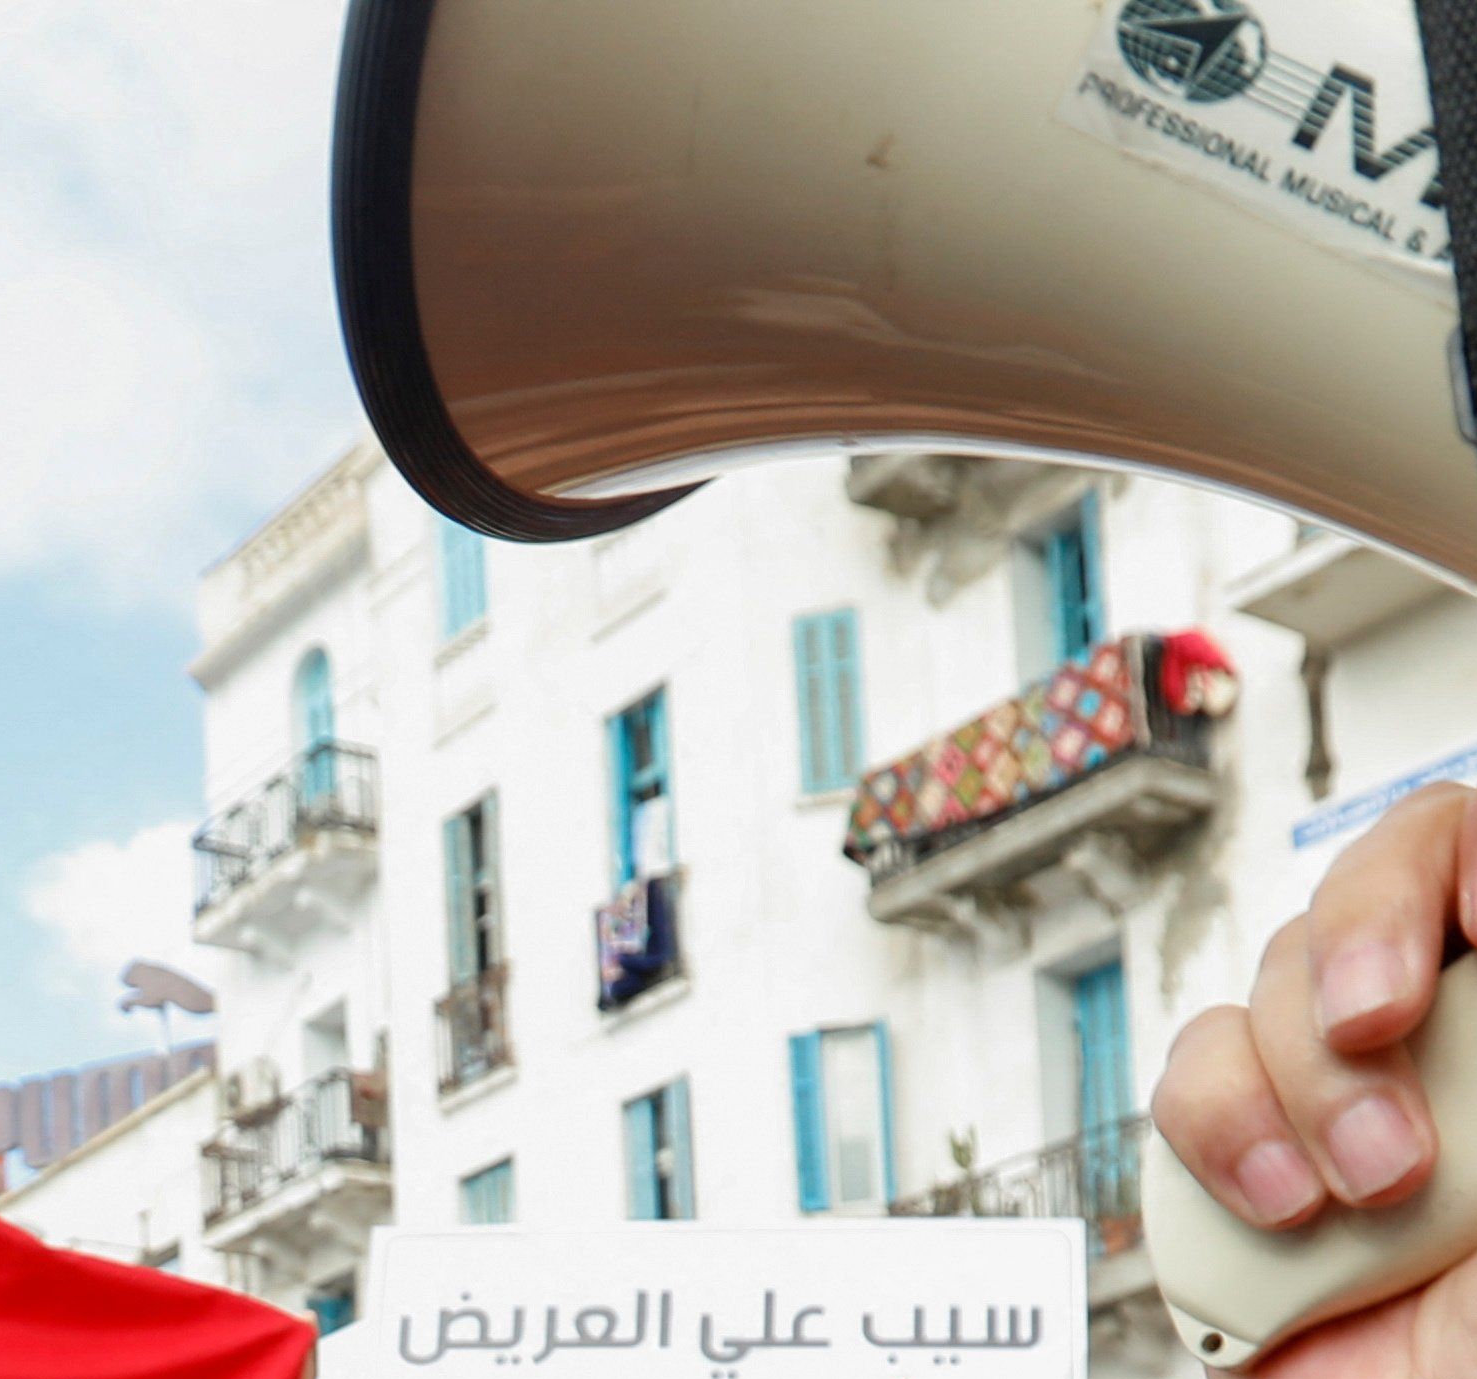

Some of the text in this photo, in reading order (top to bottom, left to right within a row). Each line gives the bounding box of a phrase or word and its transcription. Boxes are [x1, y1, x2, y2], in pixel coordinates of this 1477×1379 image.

[1077, 71, 1429, 254] PROFESSIONAL MUSICAL &
[398, 1288, 674, 1367] العريض
[862, 1304, 1043, 1367] سيب
